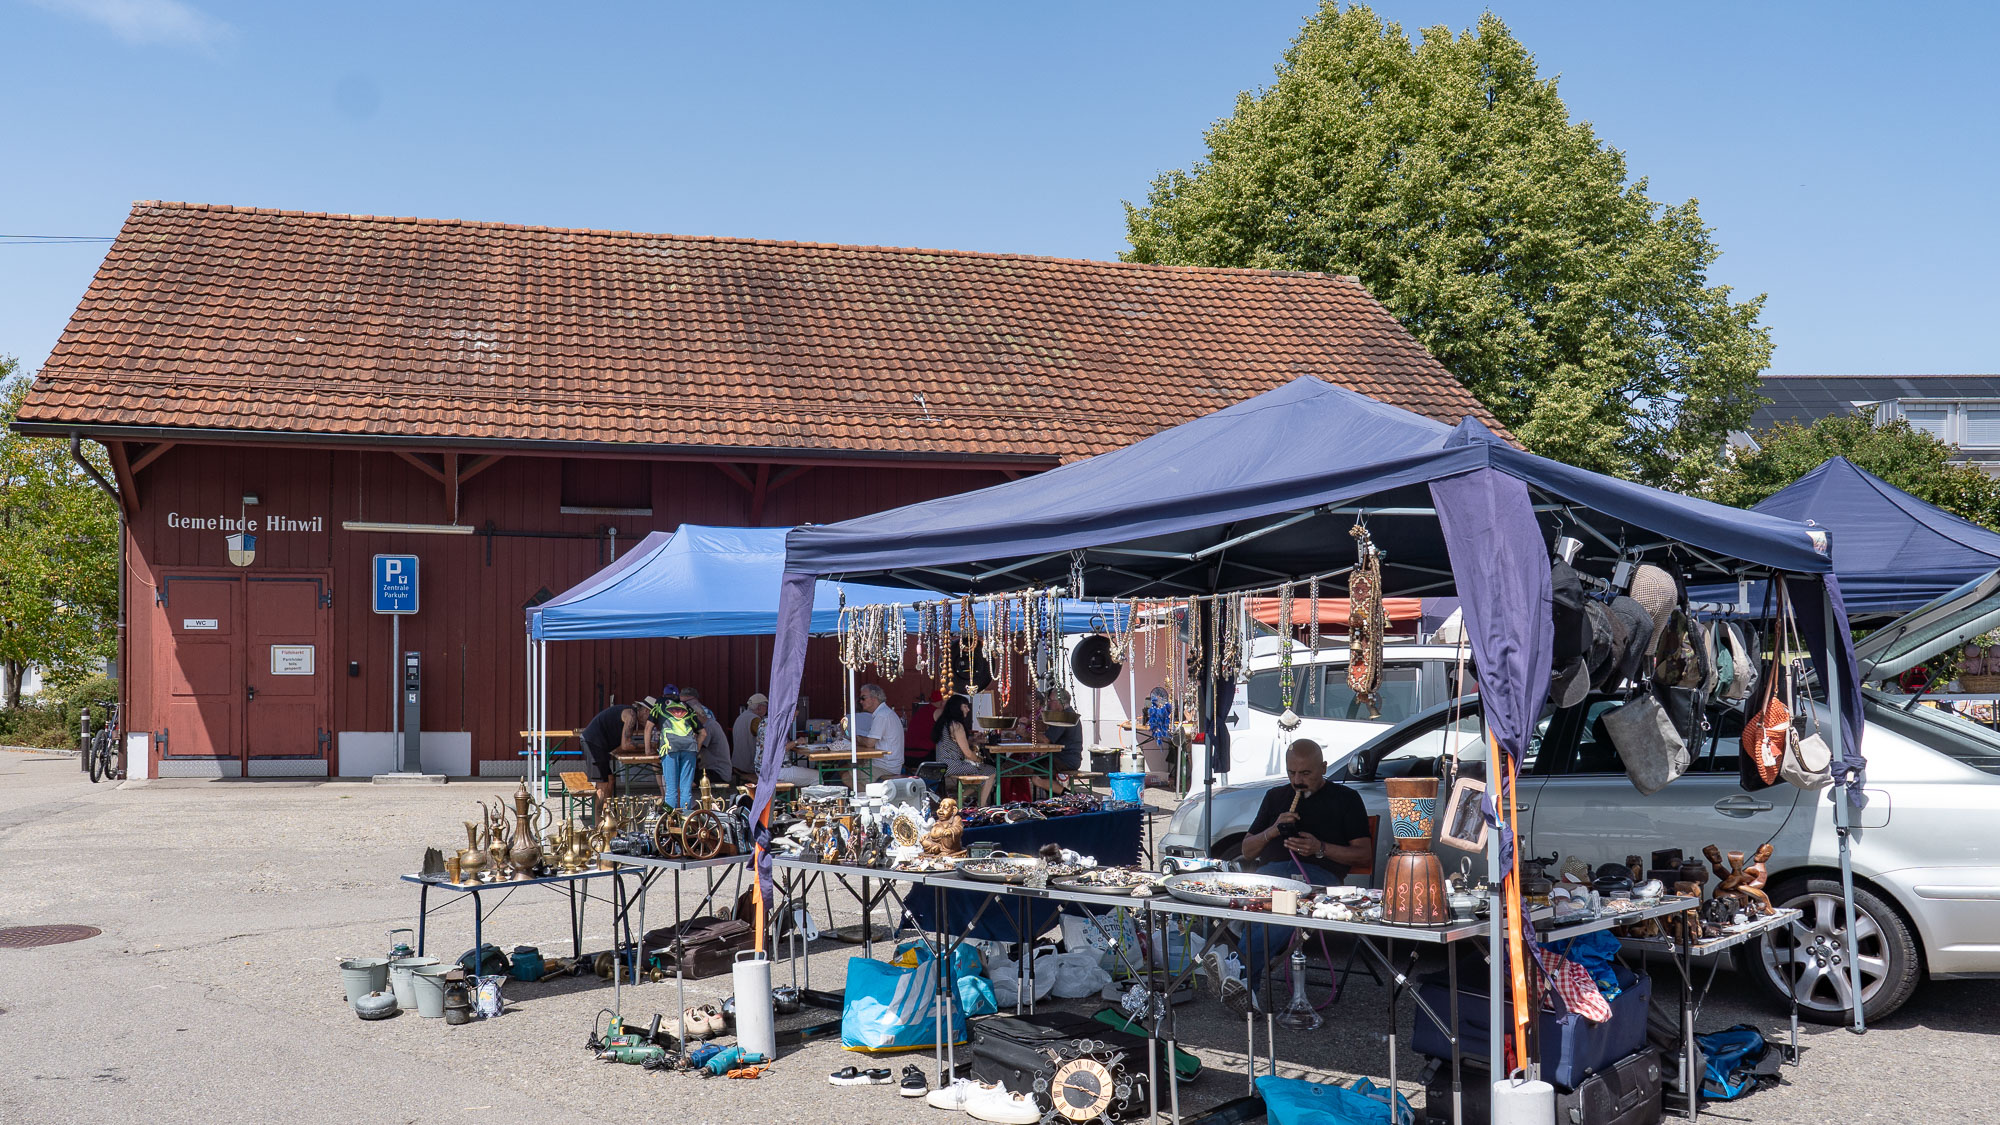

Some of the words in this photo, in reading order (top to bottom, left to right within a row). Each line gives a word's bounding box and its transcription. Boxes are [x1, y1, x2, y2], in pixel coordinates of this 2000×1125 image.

[167, 512, 258, 531] Gemeinde
[266, 515, 323, 532] Hinwil
[385, 559, 402, 582] P
